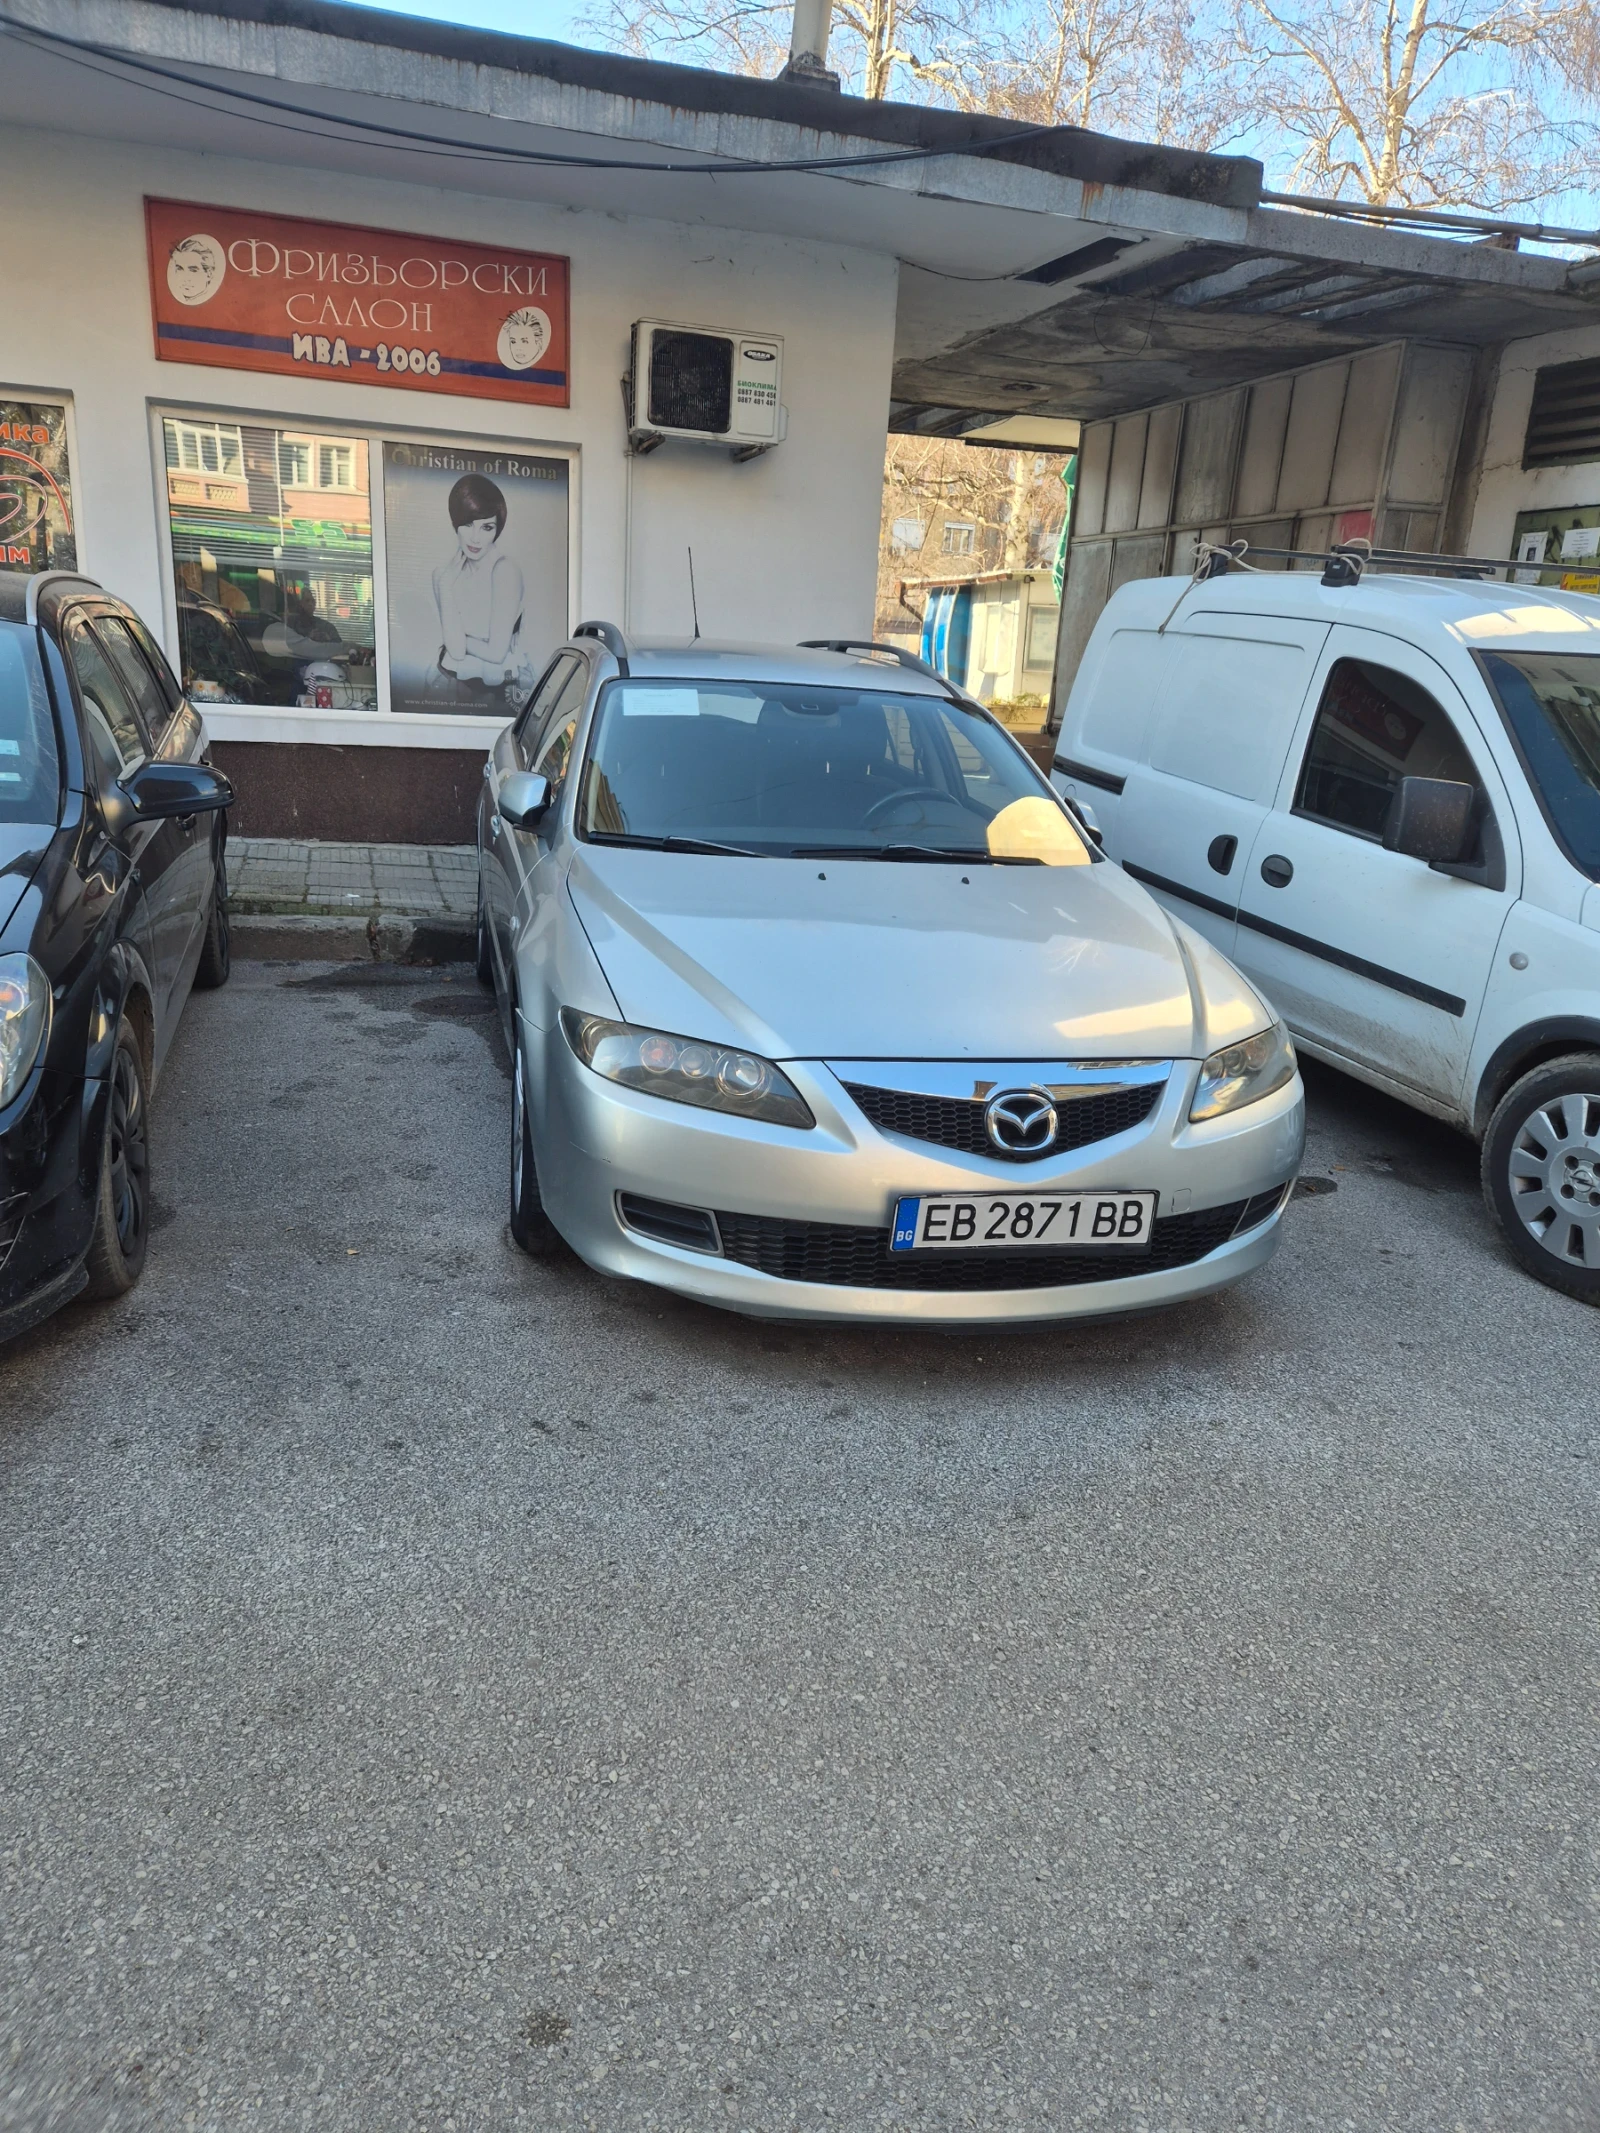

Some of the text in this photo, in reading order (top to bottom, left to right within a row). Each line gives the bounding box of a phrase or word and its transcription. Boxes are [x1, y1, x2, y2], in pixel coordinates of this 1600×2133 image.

[228, 238, 548, 296] ФРИЗЬОРСКИ
[285, 293, 433, 332] САЛОН
[291, 331, 351, 368] ИВА
[375, 342, 442, 377] 2006
[391, 447, 558, 480] Christian of Roma
[896, 1230, 914, 1242] BG
[922, 1200, 1144, 1242] EB 2871 BB
